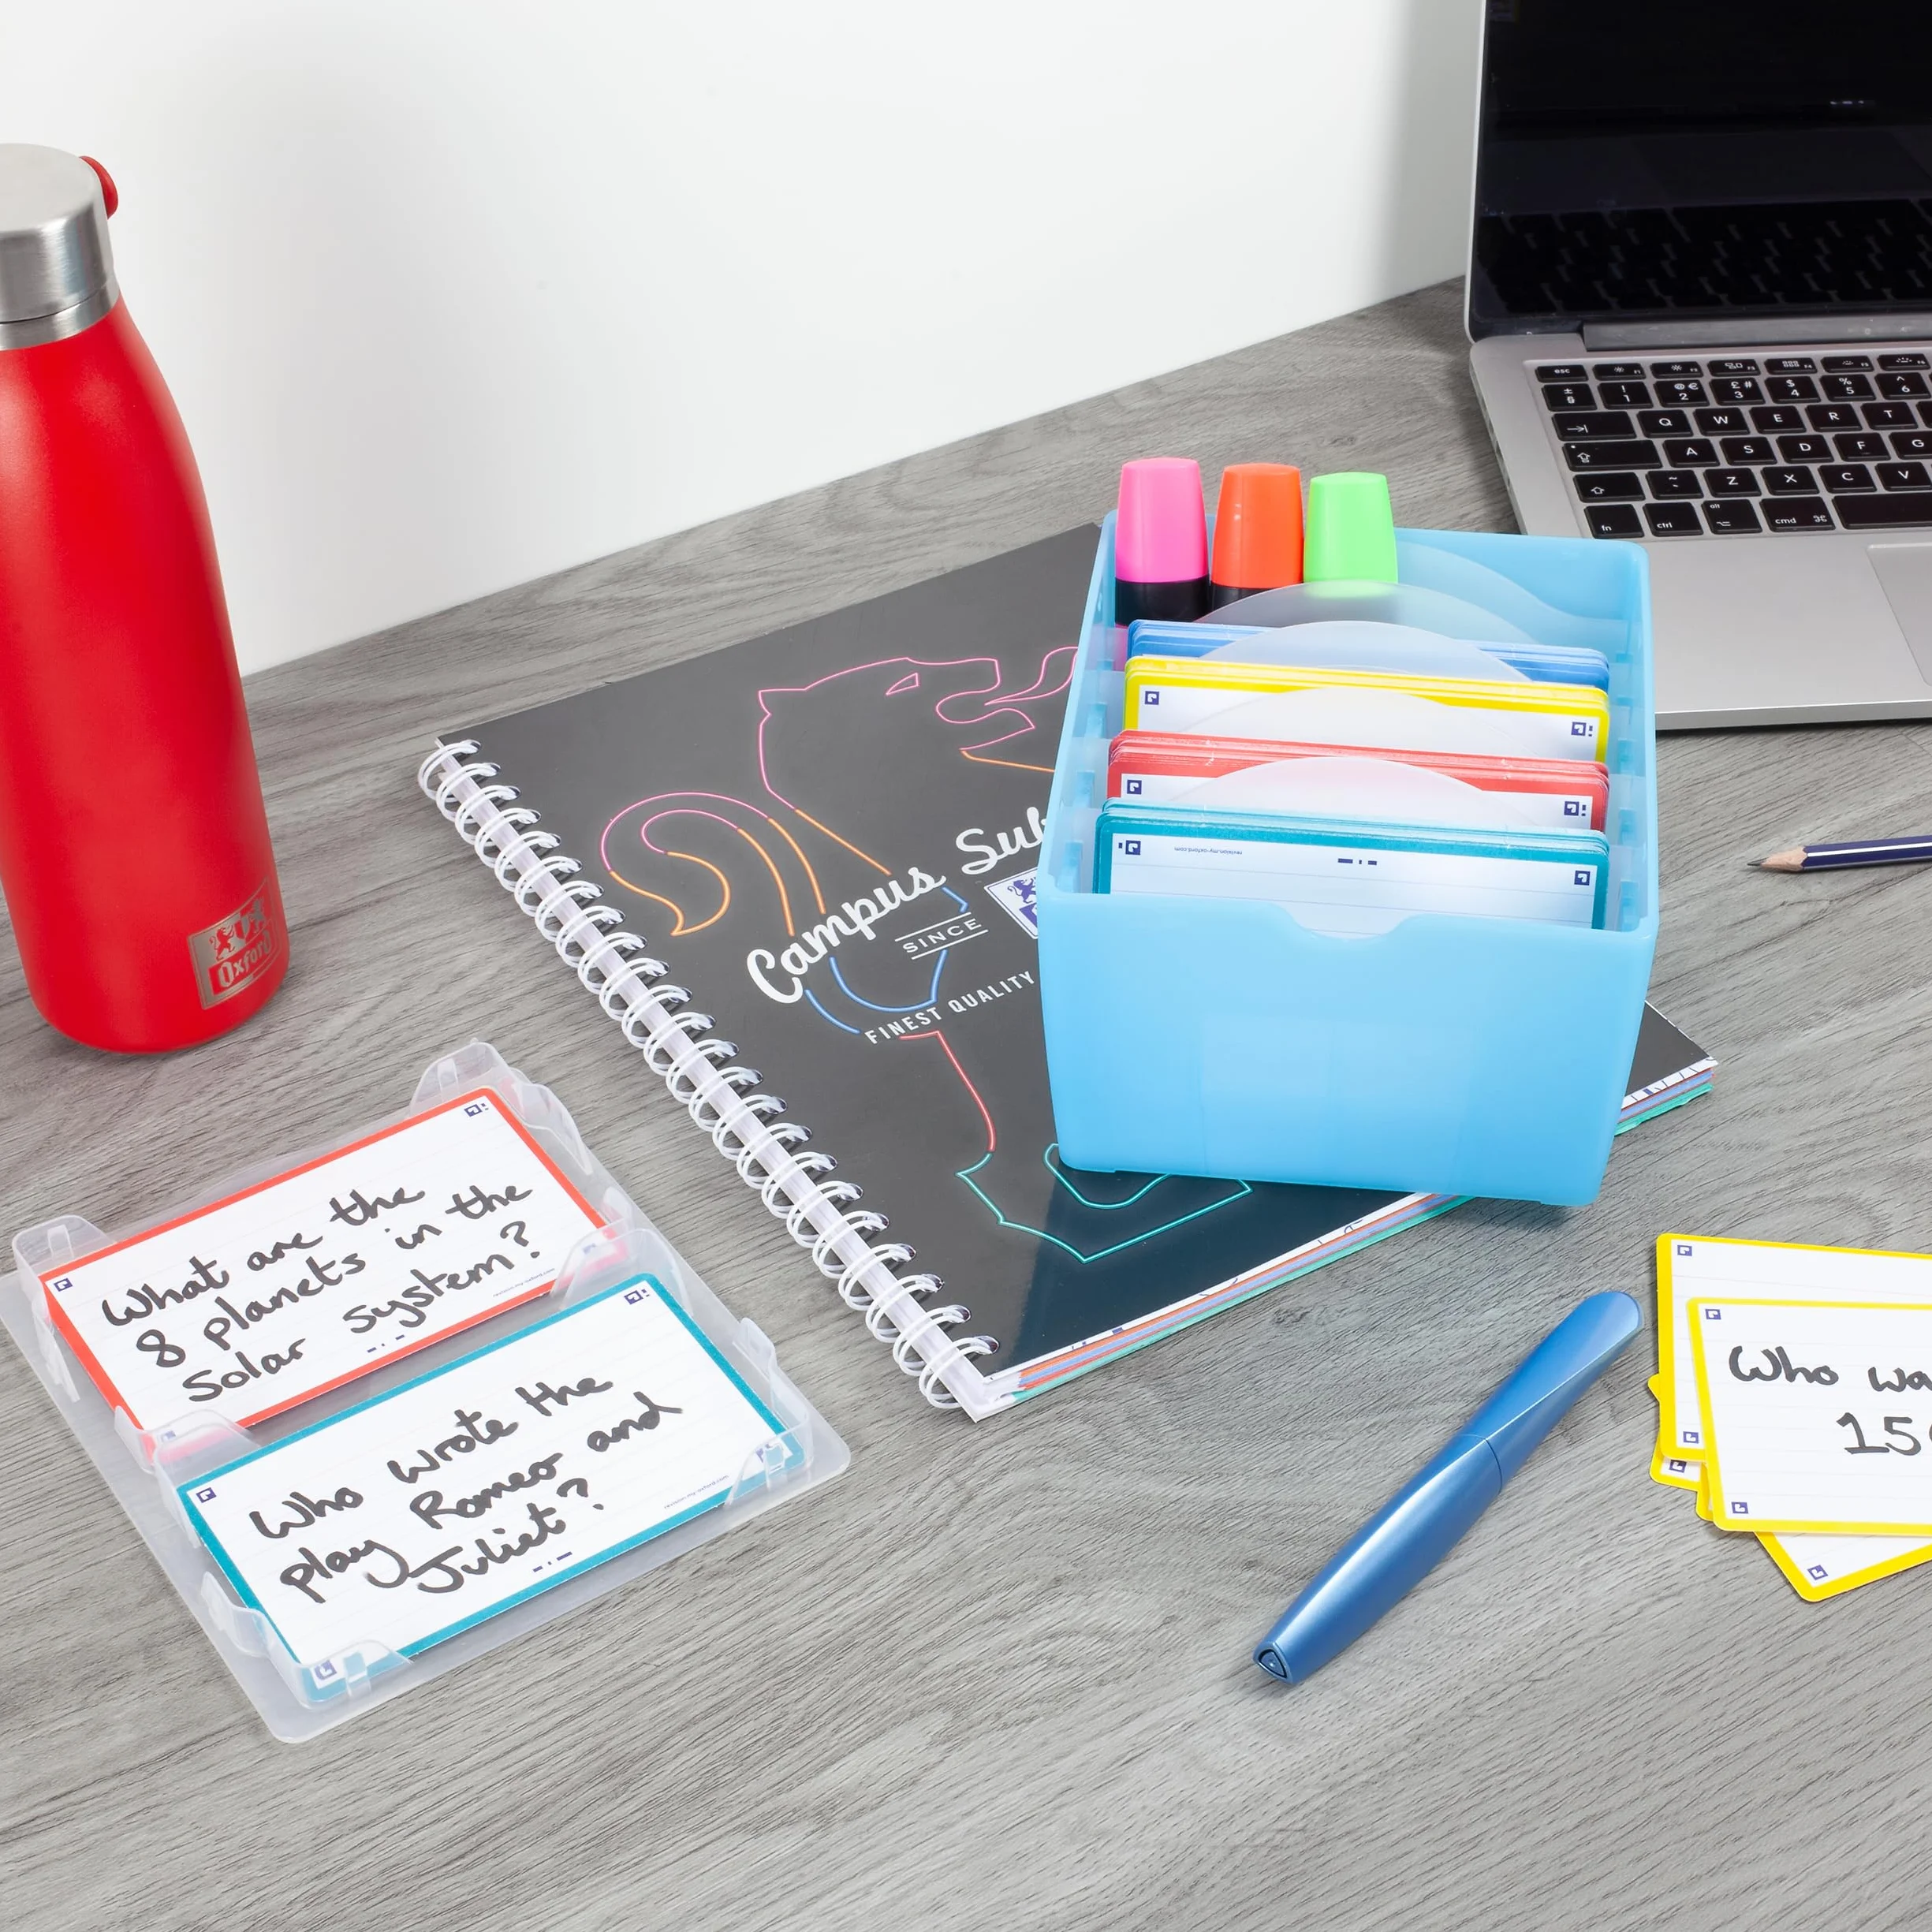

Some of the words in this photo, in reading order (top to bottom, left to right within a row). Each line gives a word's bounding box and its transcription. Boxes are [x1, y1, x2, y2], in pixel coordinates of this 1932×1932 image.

[1773, 414, 1783, 423] E
[1828, 412, 1840, 420] R
[1883, 409, 1893, 418] T
[1658, 418, 1673, 427] Q
[1713, 416, 1729, 424] W
[1799, 442, 1811, 452] D
[1856, 441, 1866, 449] F
[1911, 439, 1925, 448] G
[1686, 447, 1698, 456] A
[1744, 445, 1754, 453] S
[1784, 474, 1797, 483] X
[1841, 472, 1854, 481] C
[1897, 470, 1909, 479] V
[1726, 476, 1739, 486] Z
[747, 867, 946, 1004] Campus
[902, 918, 983, 953] SINCE
[218, 929, 273, 988] Oxford
[864, 1006, 942, 1045] FINEST
[948, 971, 1035, 1013] QUALITY
[101, 1255, 230, 1326] What
[246, 1232, 324, 1272] are
[329, 1187, 426, 1226] the
[136, 1329, 187, 1368] 8
[203, 1252, 367, 1351] planets
[385, 1222, 442, 1250] in
[445, 1185, 534, 1219] the
[181, 1337, 307, 1402] Solar
[1728, 1345, 1840, 1386] Who
[1836, 1412, 1932, 1456] 15
[249, 1486, 364, 1540] Who
[514, 1374, 614, 1416] the
[280, 1539, 410, 1604] play
[408, 1452, 565, 1530] Romeo
[587, 1390, 684, 1453] and
